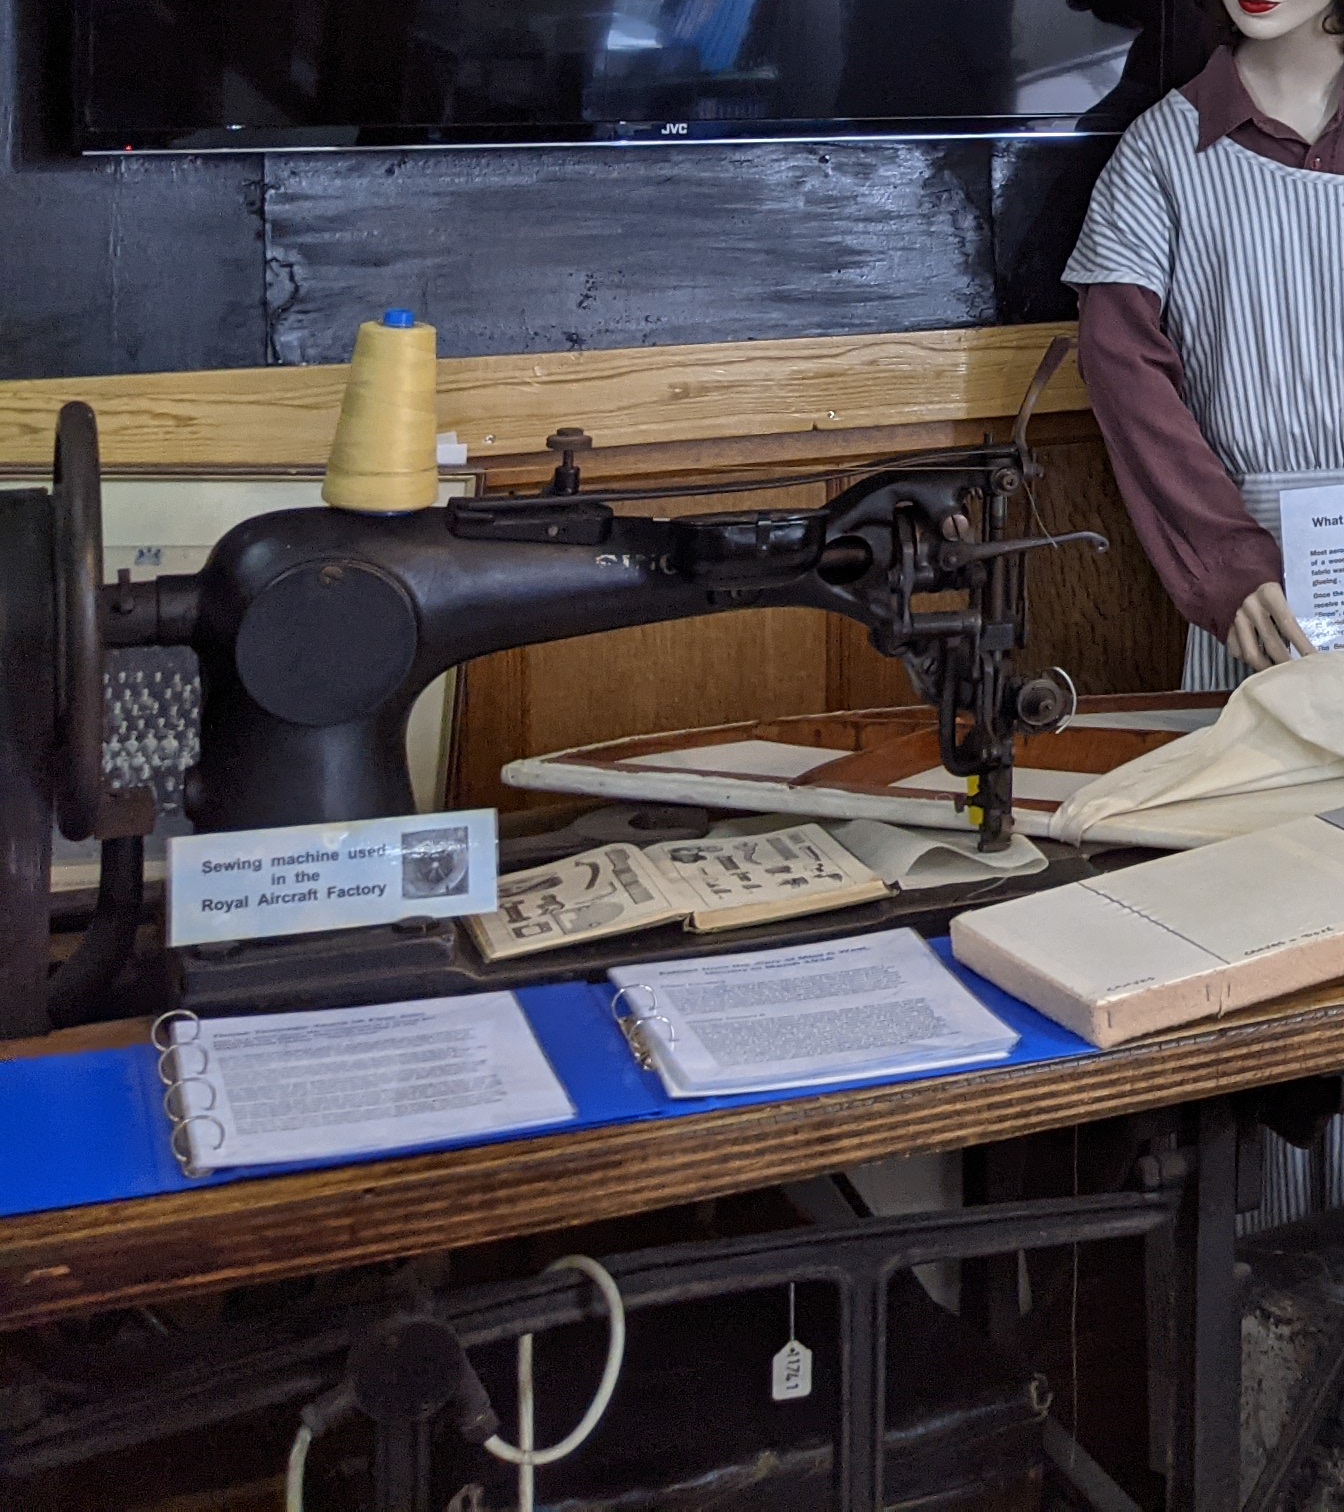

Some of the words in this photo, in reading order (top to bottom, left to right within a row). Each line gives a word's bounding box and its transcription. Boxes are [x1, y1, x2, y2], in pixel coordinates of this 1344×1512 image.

[661, 123, 687, 134] JVC
[1312, 514, 1343, 528] What
[202, 858, 262, 874] Sewing
[270, 851, 339, 867] machine
[347, 844, 386, 859] used
[271, 873, 286, 885] in
[294, 871, 320, 884] the
[202, 896, 249, 913] Royal
[257, 889, 318, 906] Aircraft
[326, 885, 386, 900] Factory
